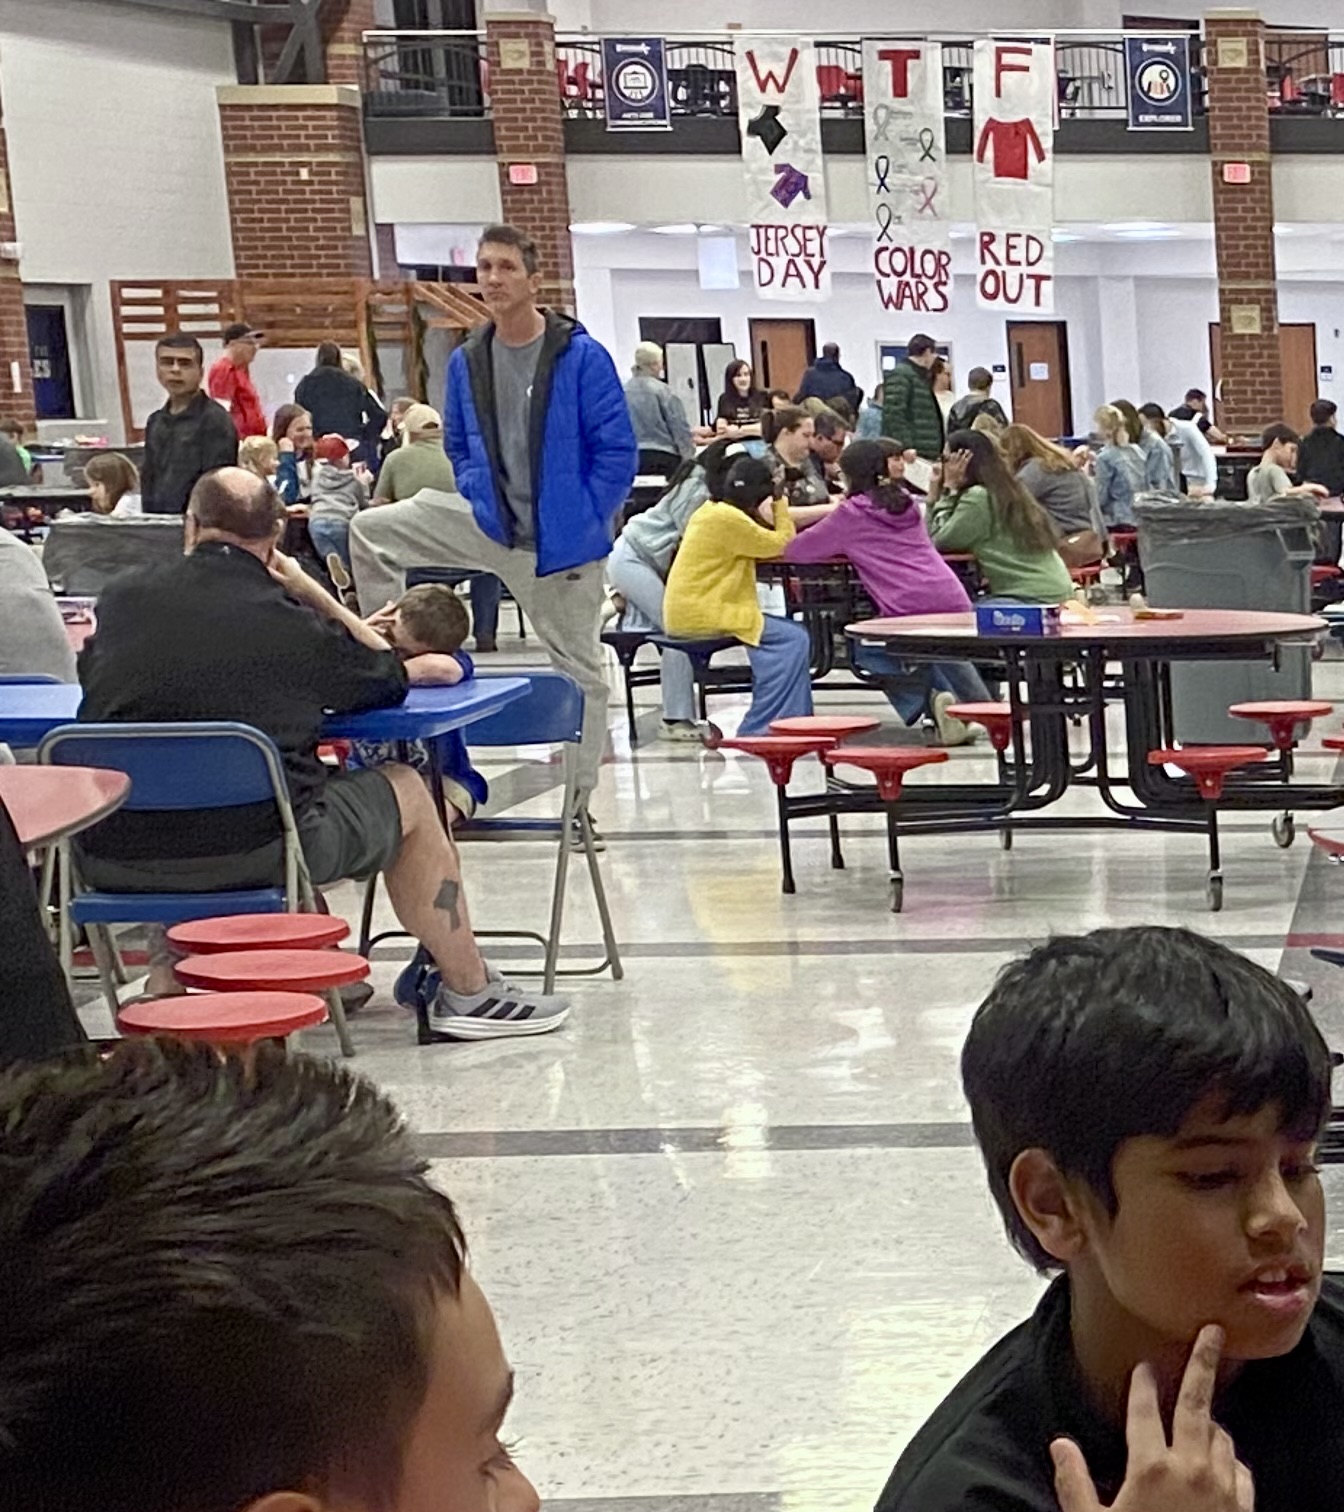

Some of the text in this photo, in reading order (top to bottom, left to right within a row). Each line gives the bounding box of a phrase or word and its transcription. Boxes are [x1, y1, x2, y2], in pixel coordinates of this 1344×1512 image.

[745, 47, 799, 94] W
[877, 49, 921, 98] T
[994, 46, 1033, 98] F
[751, 224, 828, 259] JERSEY
[979, 232, 1044, 266] RED
[758, 258, 827, 290] DAY
[874, 246, 951, 280] COLOR
[877, 278, 949, 312] WARS
[979, 269, 1052, 307] OUT
